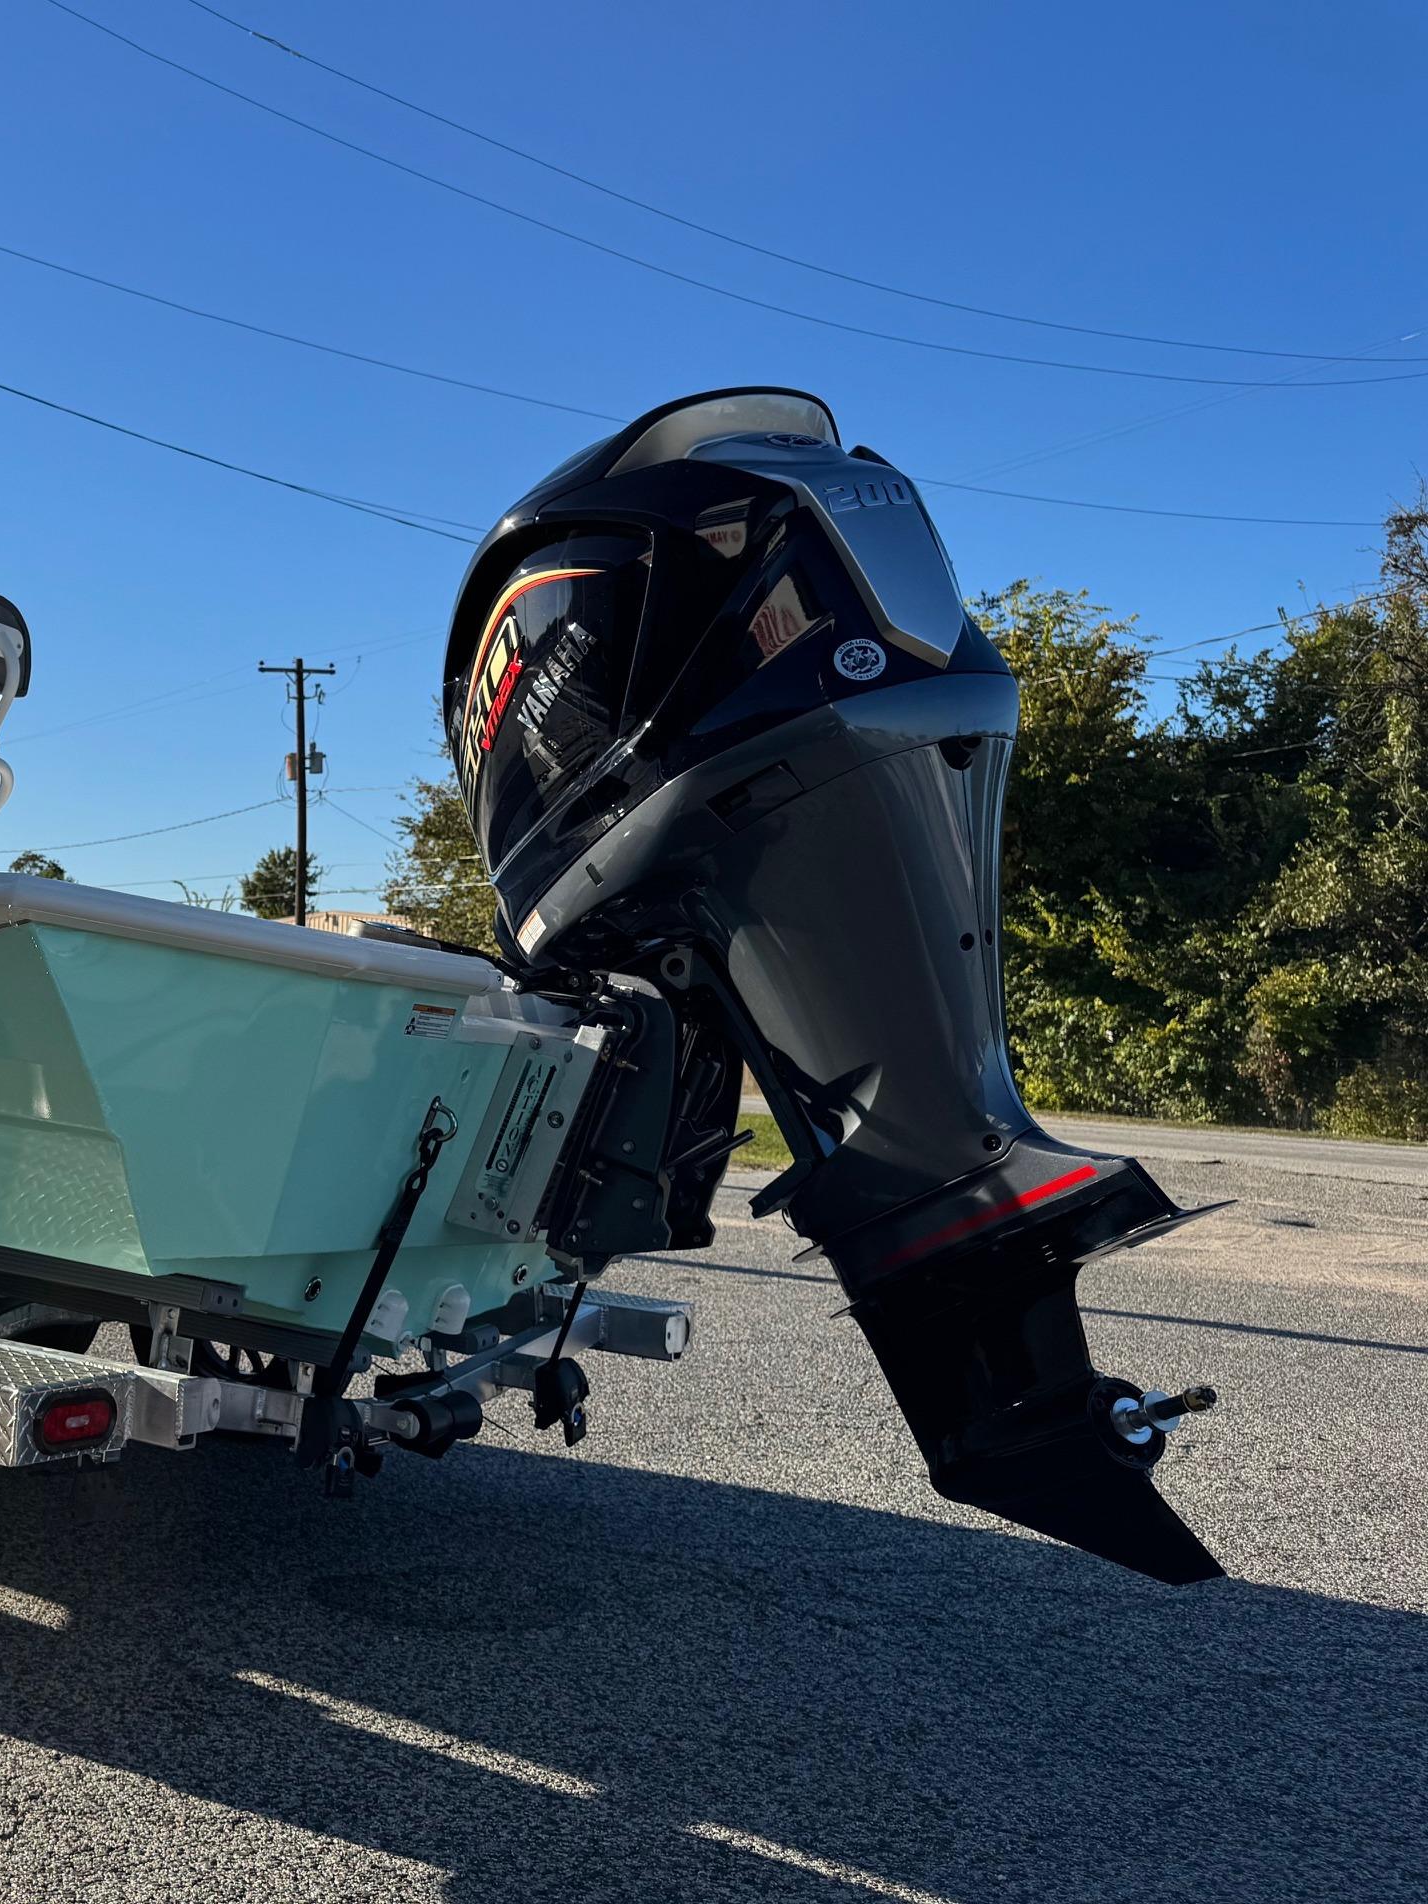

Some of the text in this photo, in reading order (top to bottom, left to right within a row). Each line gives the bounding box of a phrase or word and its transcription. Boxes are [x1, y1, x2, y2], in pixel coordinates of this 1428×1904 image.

[823, 481, 912, 514] 200
[837, 640, 855, 655] ULTRA
[517, 622, 597, 734] YAMAHA
